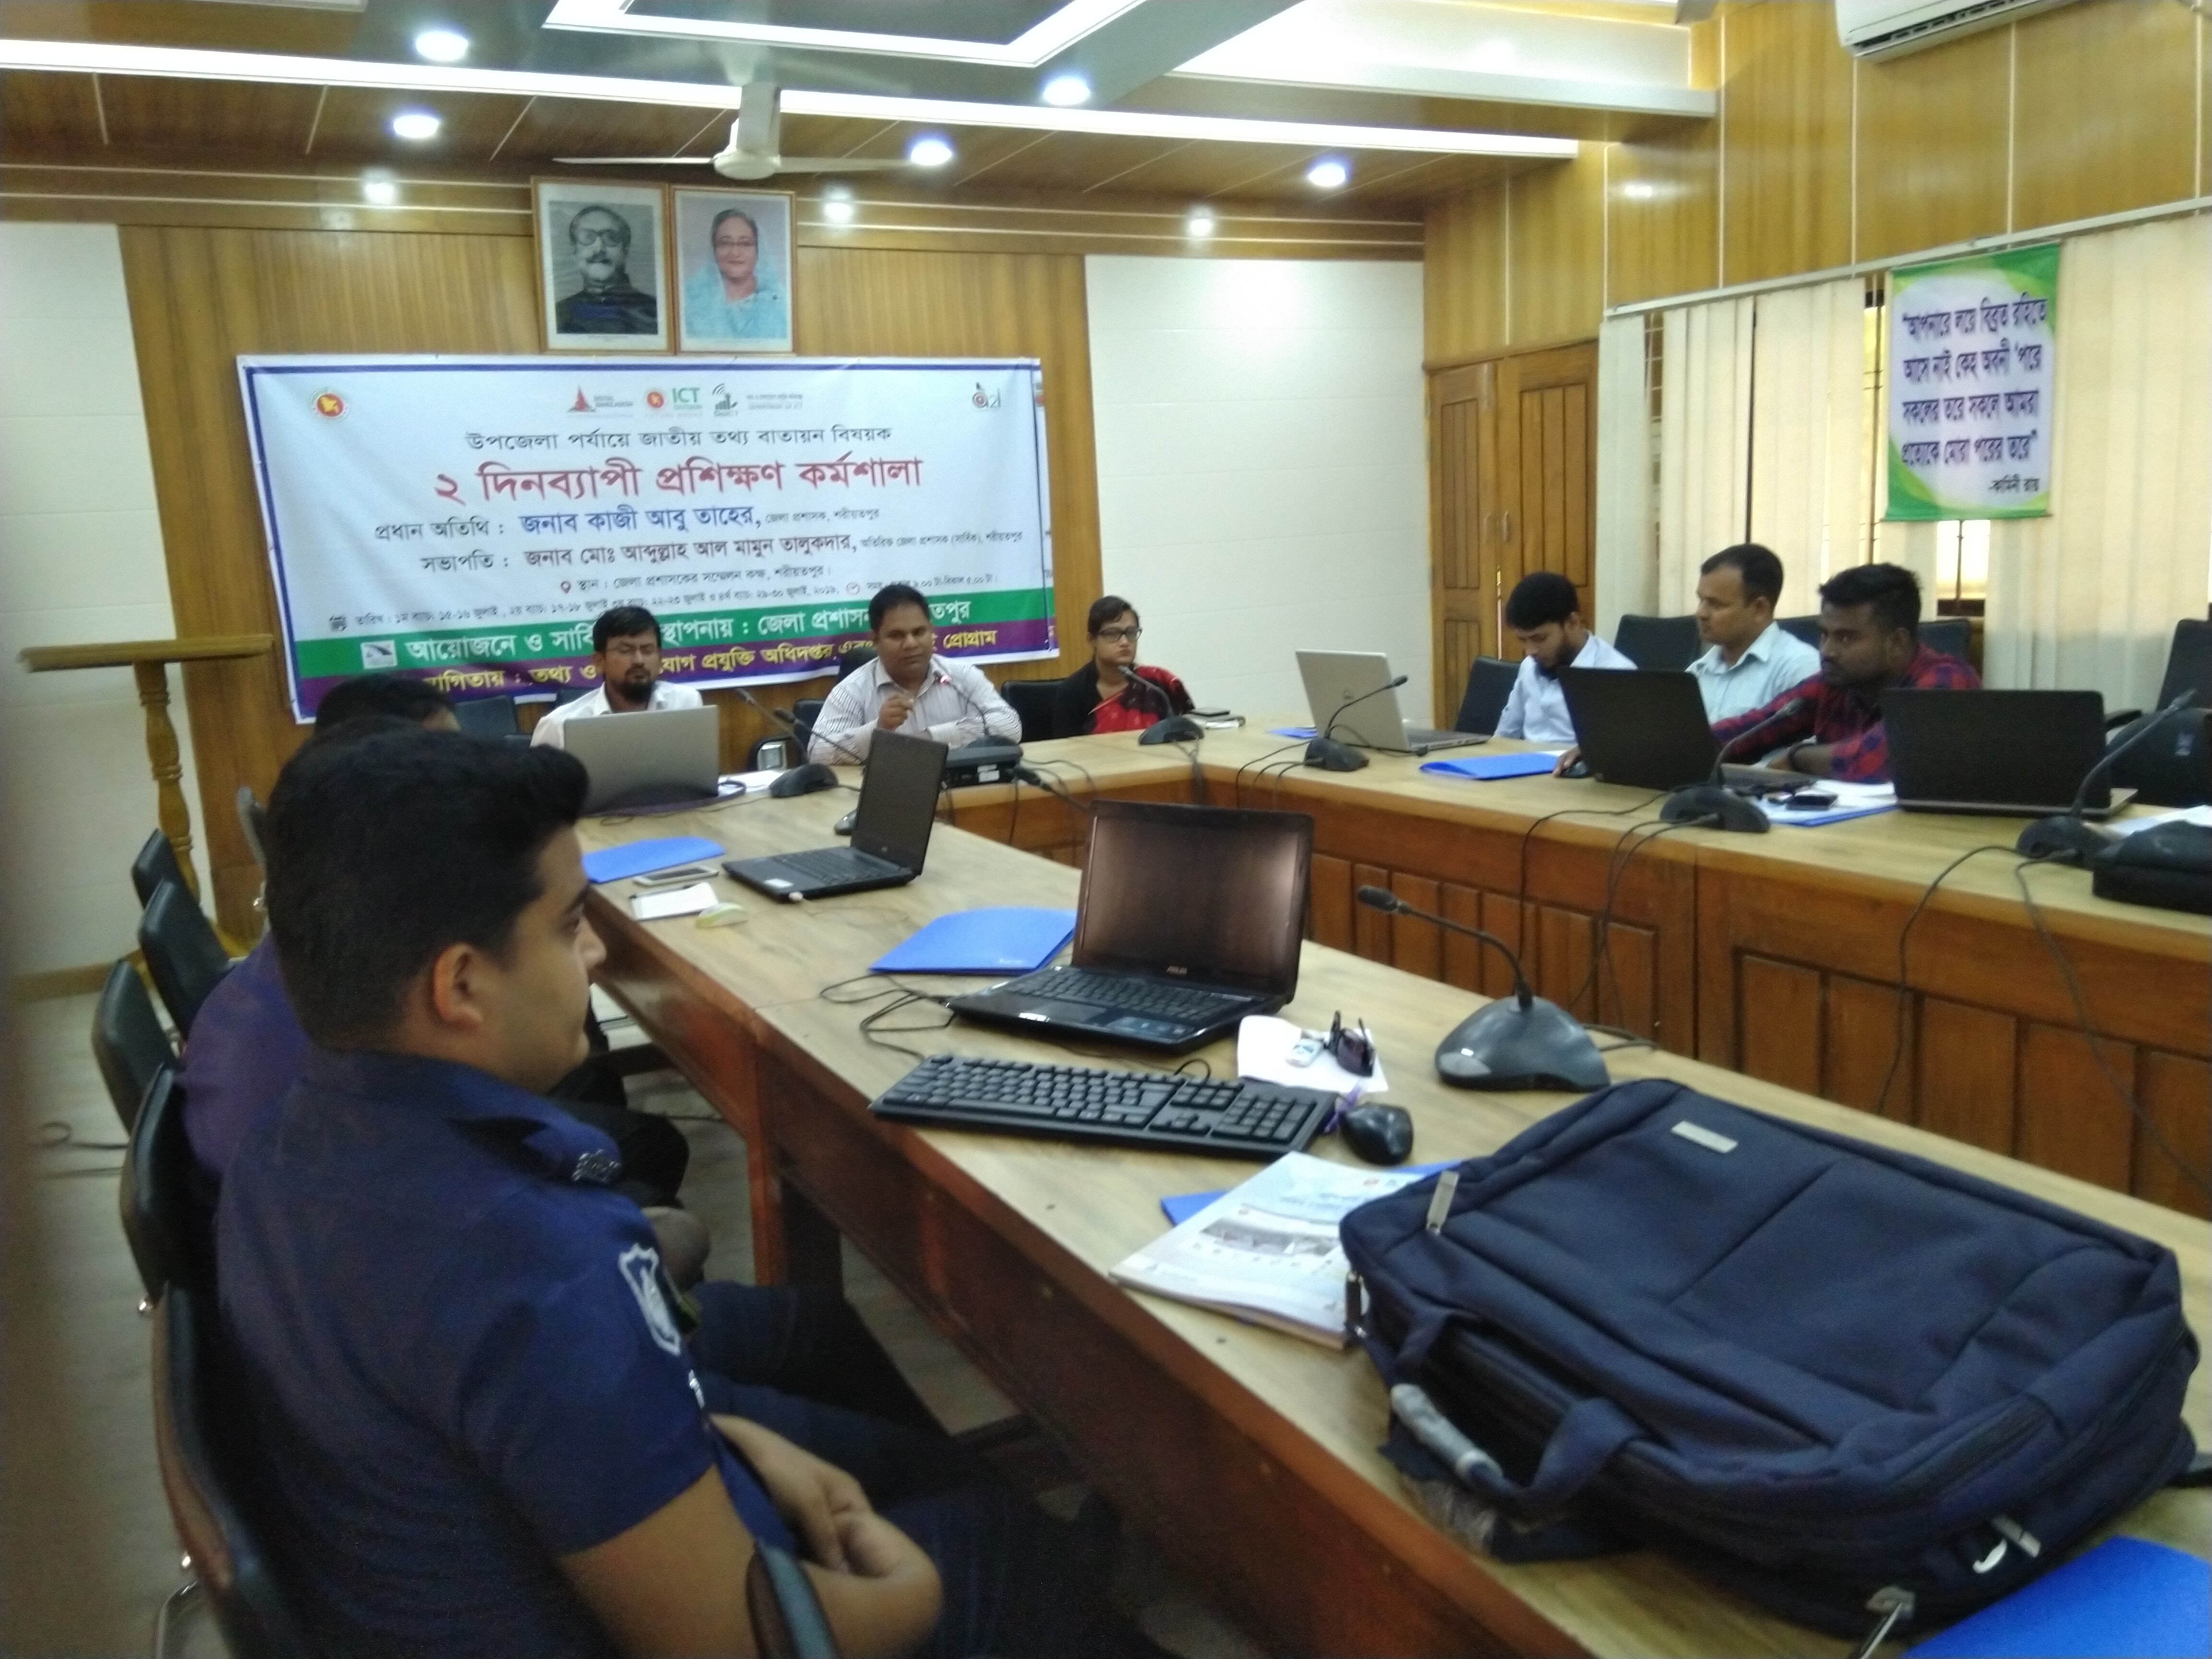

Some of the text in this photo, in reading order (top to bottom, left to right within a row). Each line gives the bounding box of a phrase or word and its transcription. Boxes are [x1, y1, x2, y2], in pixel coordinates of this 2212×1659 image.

[672, 387, 701, 403] ICT
[466, 424, 892, 450] উপজেলা পর্যায়ে জাতীয় তথ্য বাতায়ন বিষয়ক
[435, 450, 925, 505] ২ দিনব্যাপী প্রশিক্ষণ কর্মশালা
[375, 524, 424, 541] প্রধান
[430, 516, 490, 538] অতিথি
[518, 513, 579, 534] জনাব
[585, 504, 638, 531] কাজী
[645, 509, 689, 532] আবু
[421, 549, 494, 572] সভাপতি
[523, 548, 573, 566] জনাব
[580, 548, 615, 564] মোঃ
[694, 541, 728, 560] আল
[733, 538, 774, 558] মামুন
[613, 577, 642, 589] জেলা
[405, 635, 518, 661] আয়োজনে
[524, 634, 543, 652] ও
[758, 611, 805, 636] জেলা
[528, 664, 574, 684] তথ্য
[579, 664, 597, 679] ও
[701, 646, 757, 672] প্রযুক্তি
[760, 642, 835, 664] অধিদপ্তর
[943, 630, 998, 649] প্রোগ্রাম
